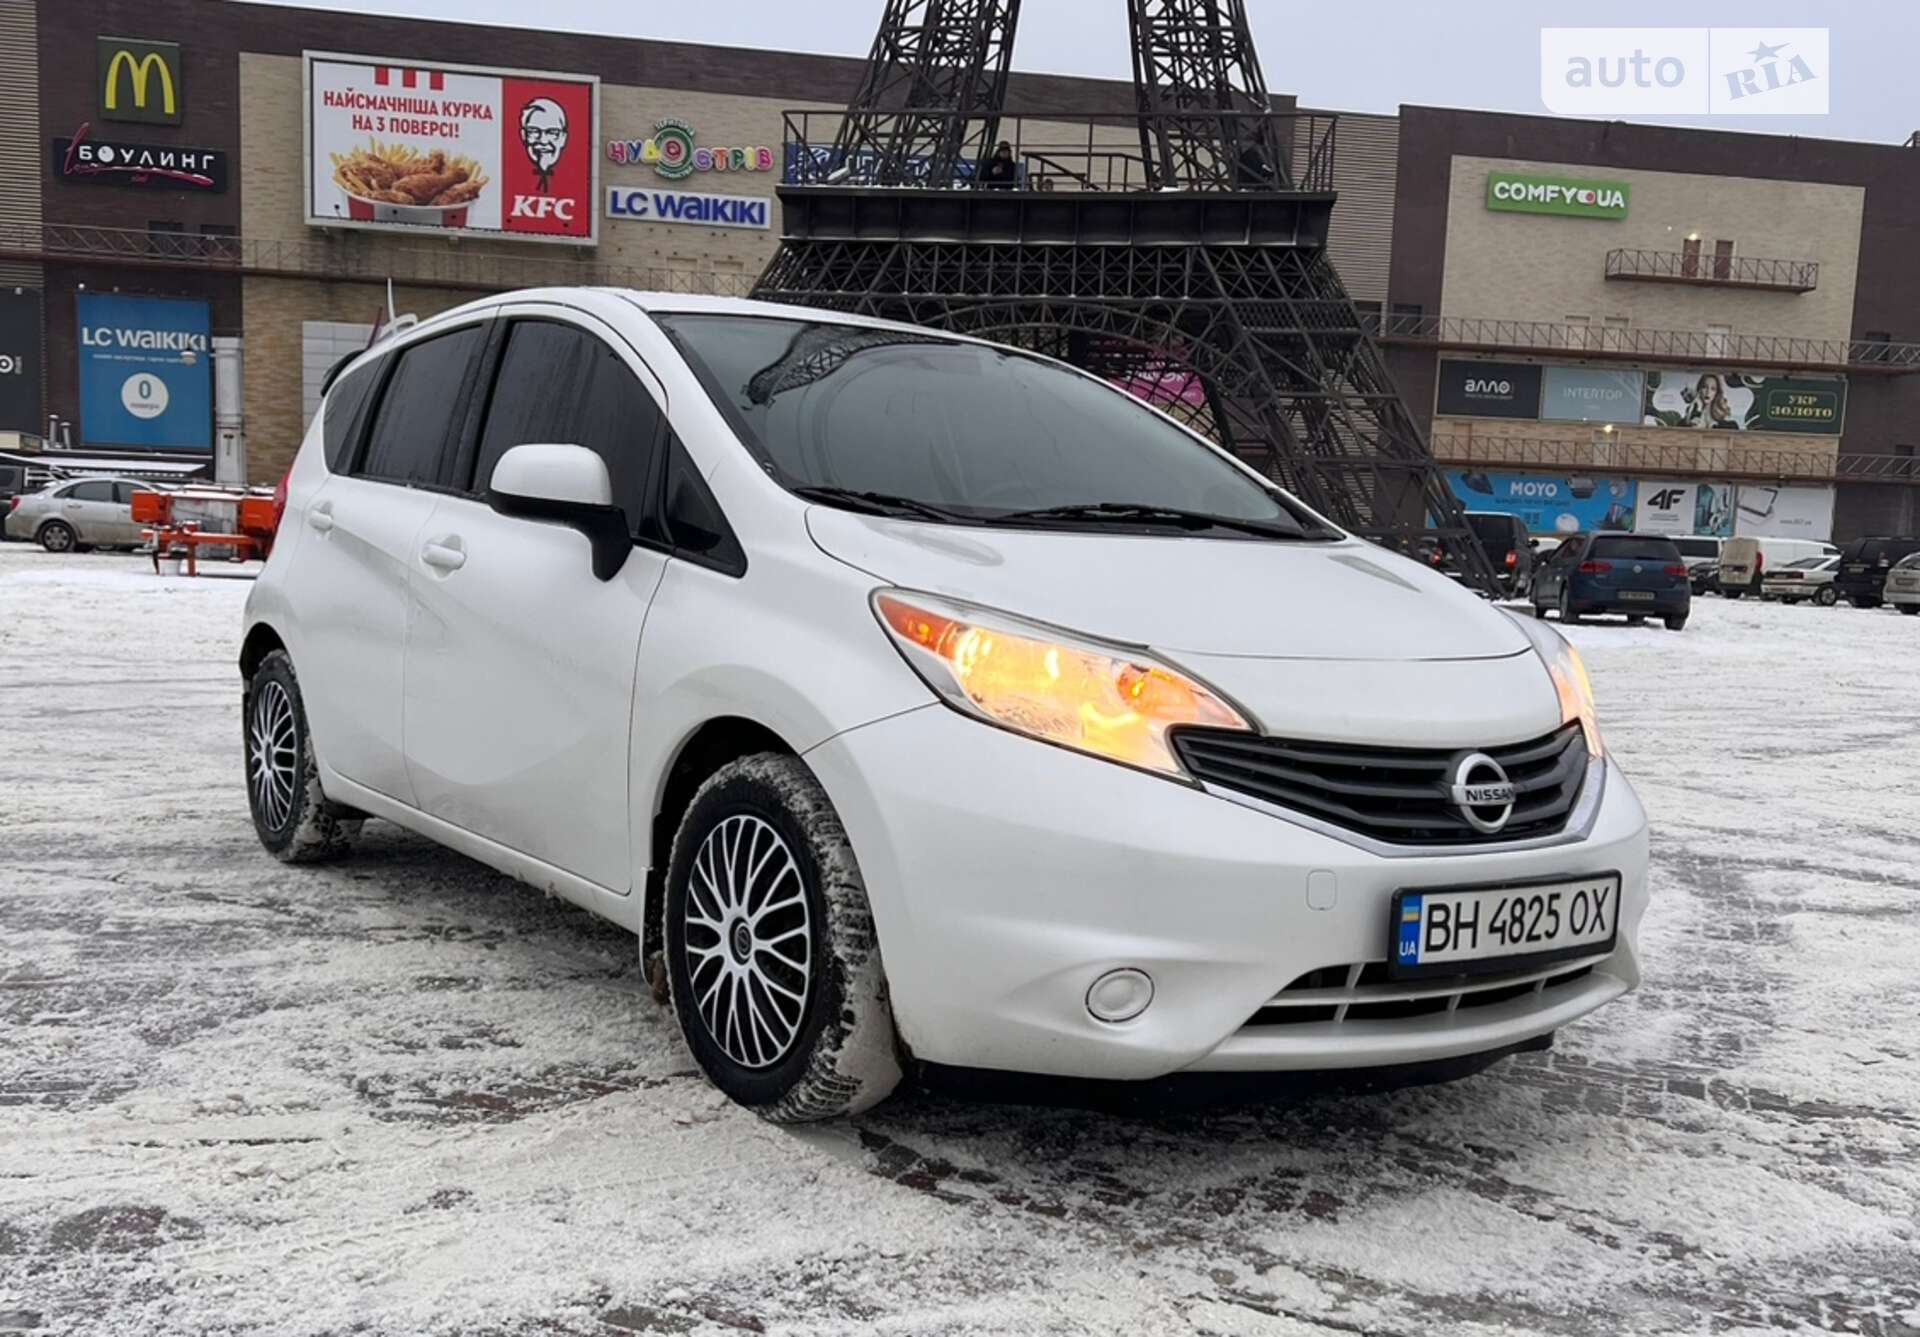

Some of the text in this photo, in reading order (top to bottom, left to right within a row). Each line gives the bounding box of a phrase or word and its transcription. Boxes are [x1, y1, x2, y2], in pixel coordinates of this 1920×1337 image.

[323, 88, 493, 121] НАЙСМАЧНІША КУРКА
[352, 115, 460, 138] НА 3 ПОВЕРСІ!
[78, 145, 215, 170] БОУЛИНГ
[511, 194, 575, 220] KFC
[611, 190, 649, 216] LC
[82, 327, 112, 346] LC
[1563, 386, 1623, 400] INTERTOP
[1788, 394, 1818, 405] УКР
[1770, 406, 1833, 418] ЗОЛОТО
[1510, 481, 1558, 497] MOYO
[1647, 489, 1686, 511] 4F
[1465, 788, 1514, 802] NISSAN
[1424, 886, 1610, 953] BH 4825 OX
[1400, 942, 1417, 957] UA
